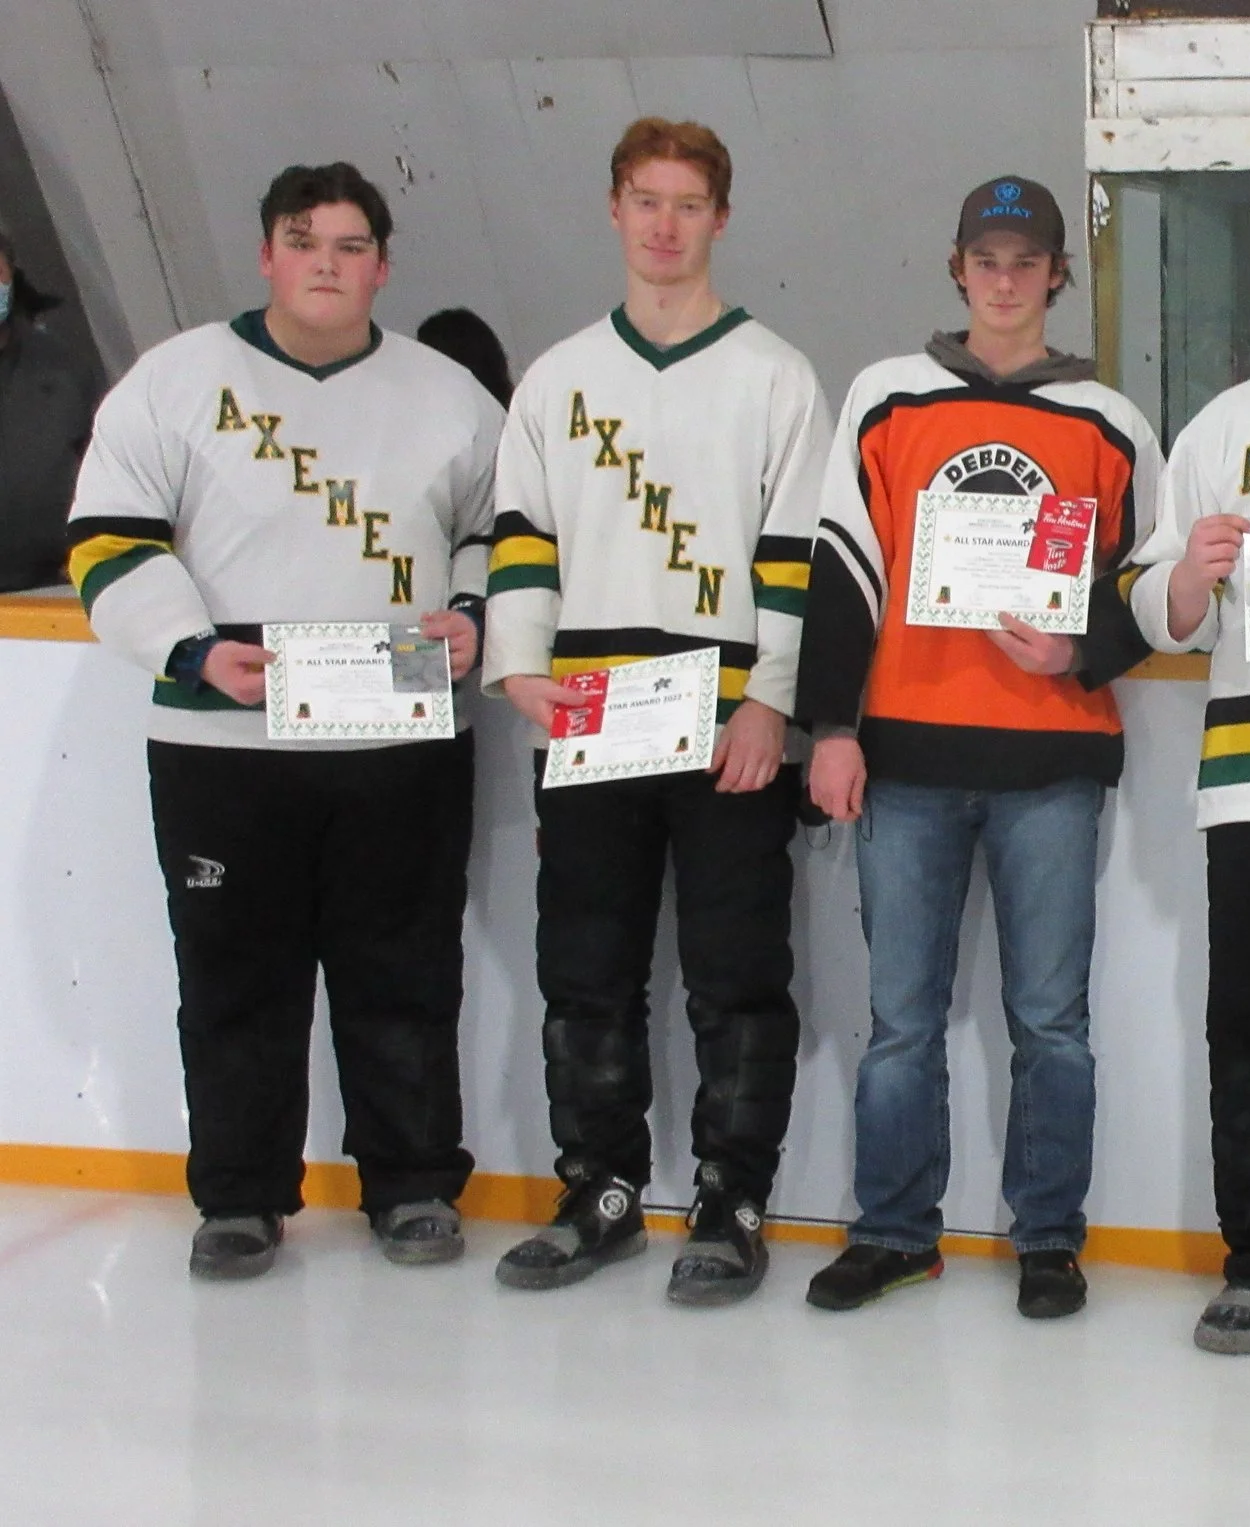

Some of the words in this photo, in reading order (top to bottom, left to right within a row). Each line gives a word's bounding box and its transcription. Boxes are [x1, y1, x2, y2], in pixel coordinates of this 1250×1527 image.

[979, 205, 1032, 219] ARIAT
[943, 448, 1044, 492] DEBDEN
[213, 384, 415, 606] AXEMEN
[567, 389, 726, 618] AXEMEN
[954, 538, 970, 546] ALL
[972, 538, 995, 547] STAR
[996, 539, 1030, 548] AWARD
[608, 702, 628, 712] STAR
[630, 697, 662, 709] AWARD
